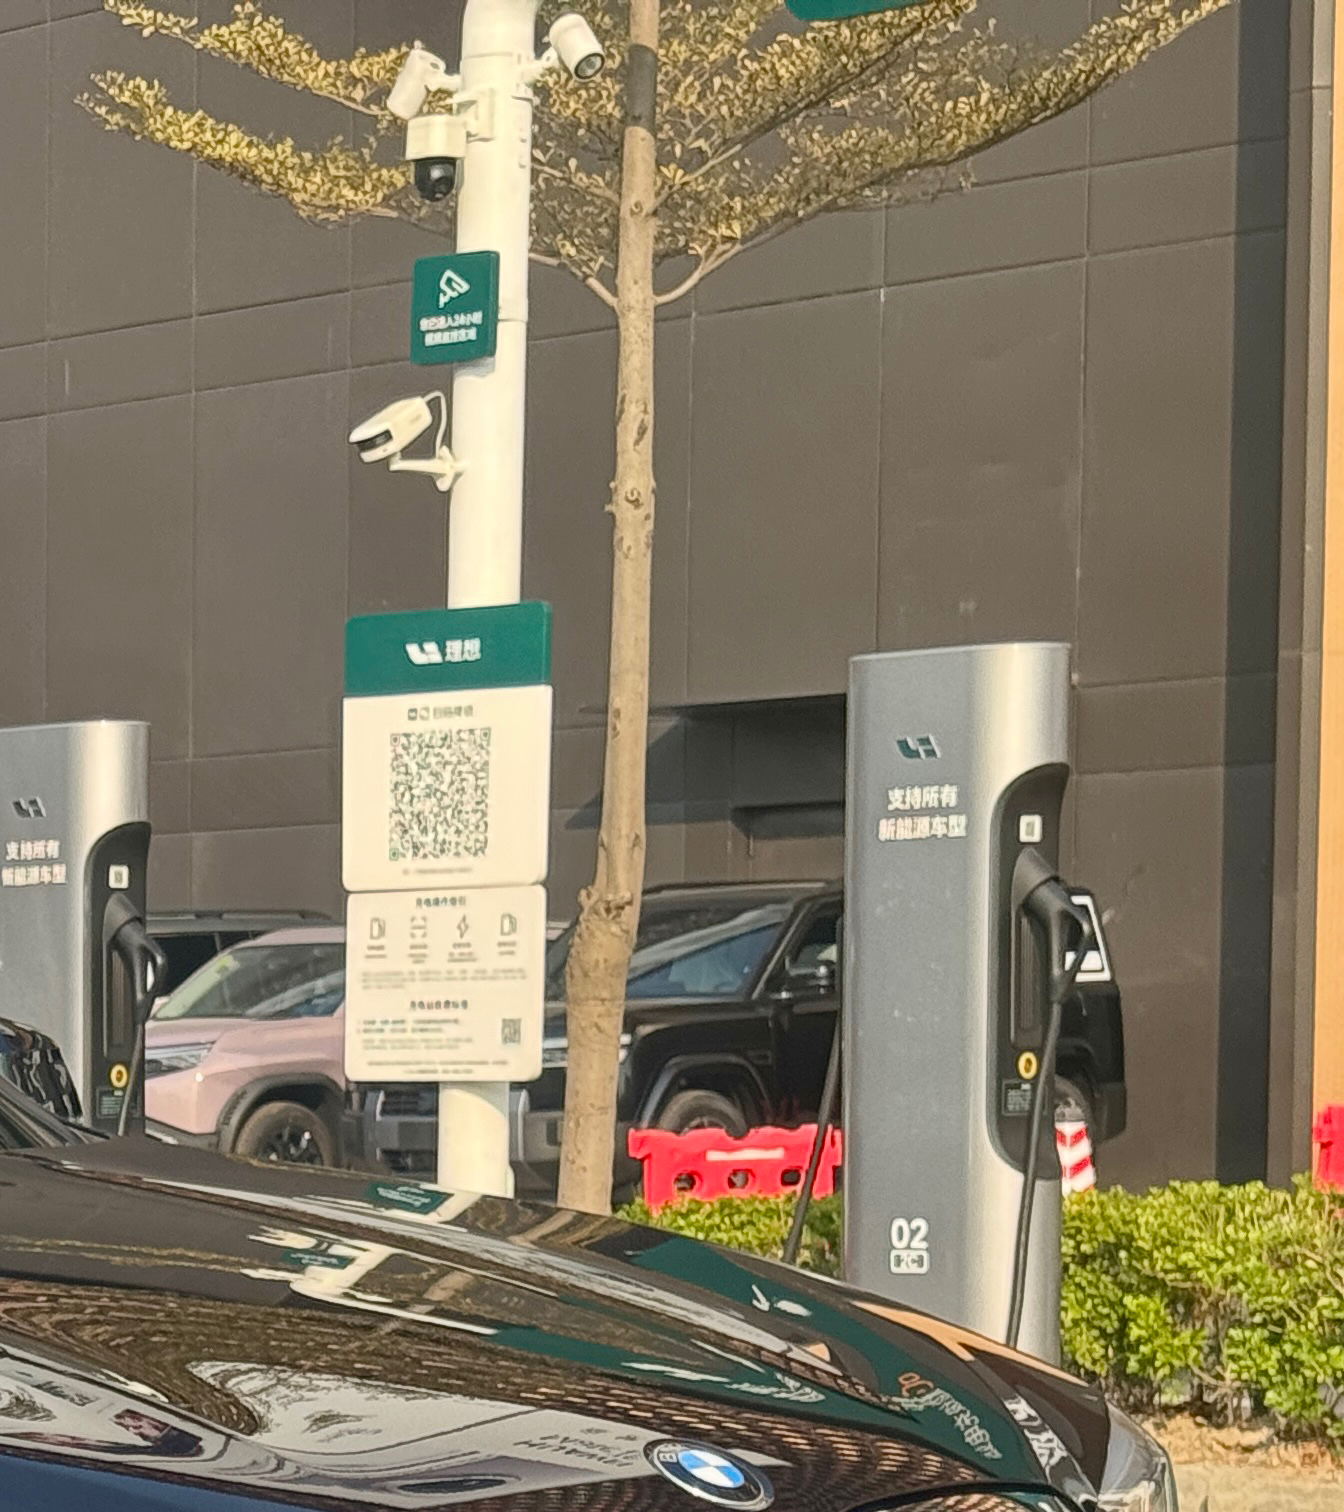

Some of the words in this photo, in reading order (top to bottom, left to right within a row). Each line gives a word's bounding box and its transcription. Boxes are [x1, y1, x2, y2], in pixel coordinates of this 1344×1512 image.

[887, 783, 959, 811] 支持所有
[878, 813, 967, 842] 新能源车型
[891, 1217, 929, 1249] 02
